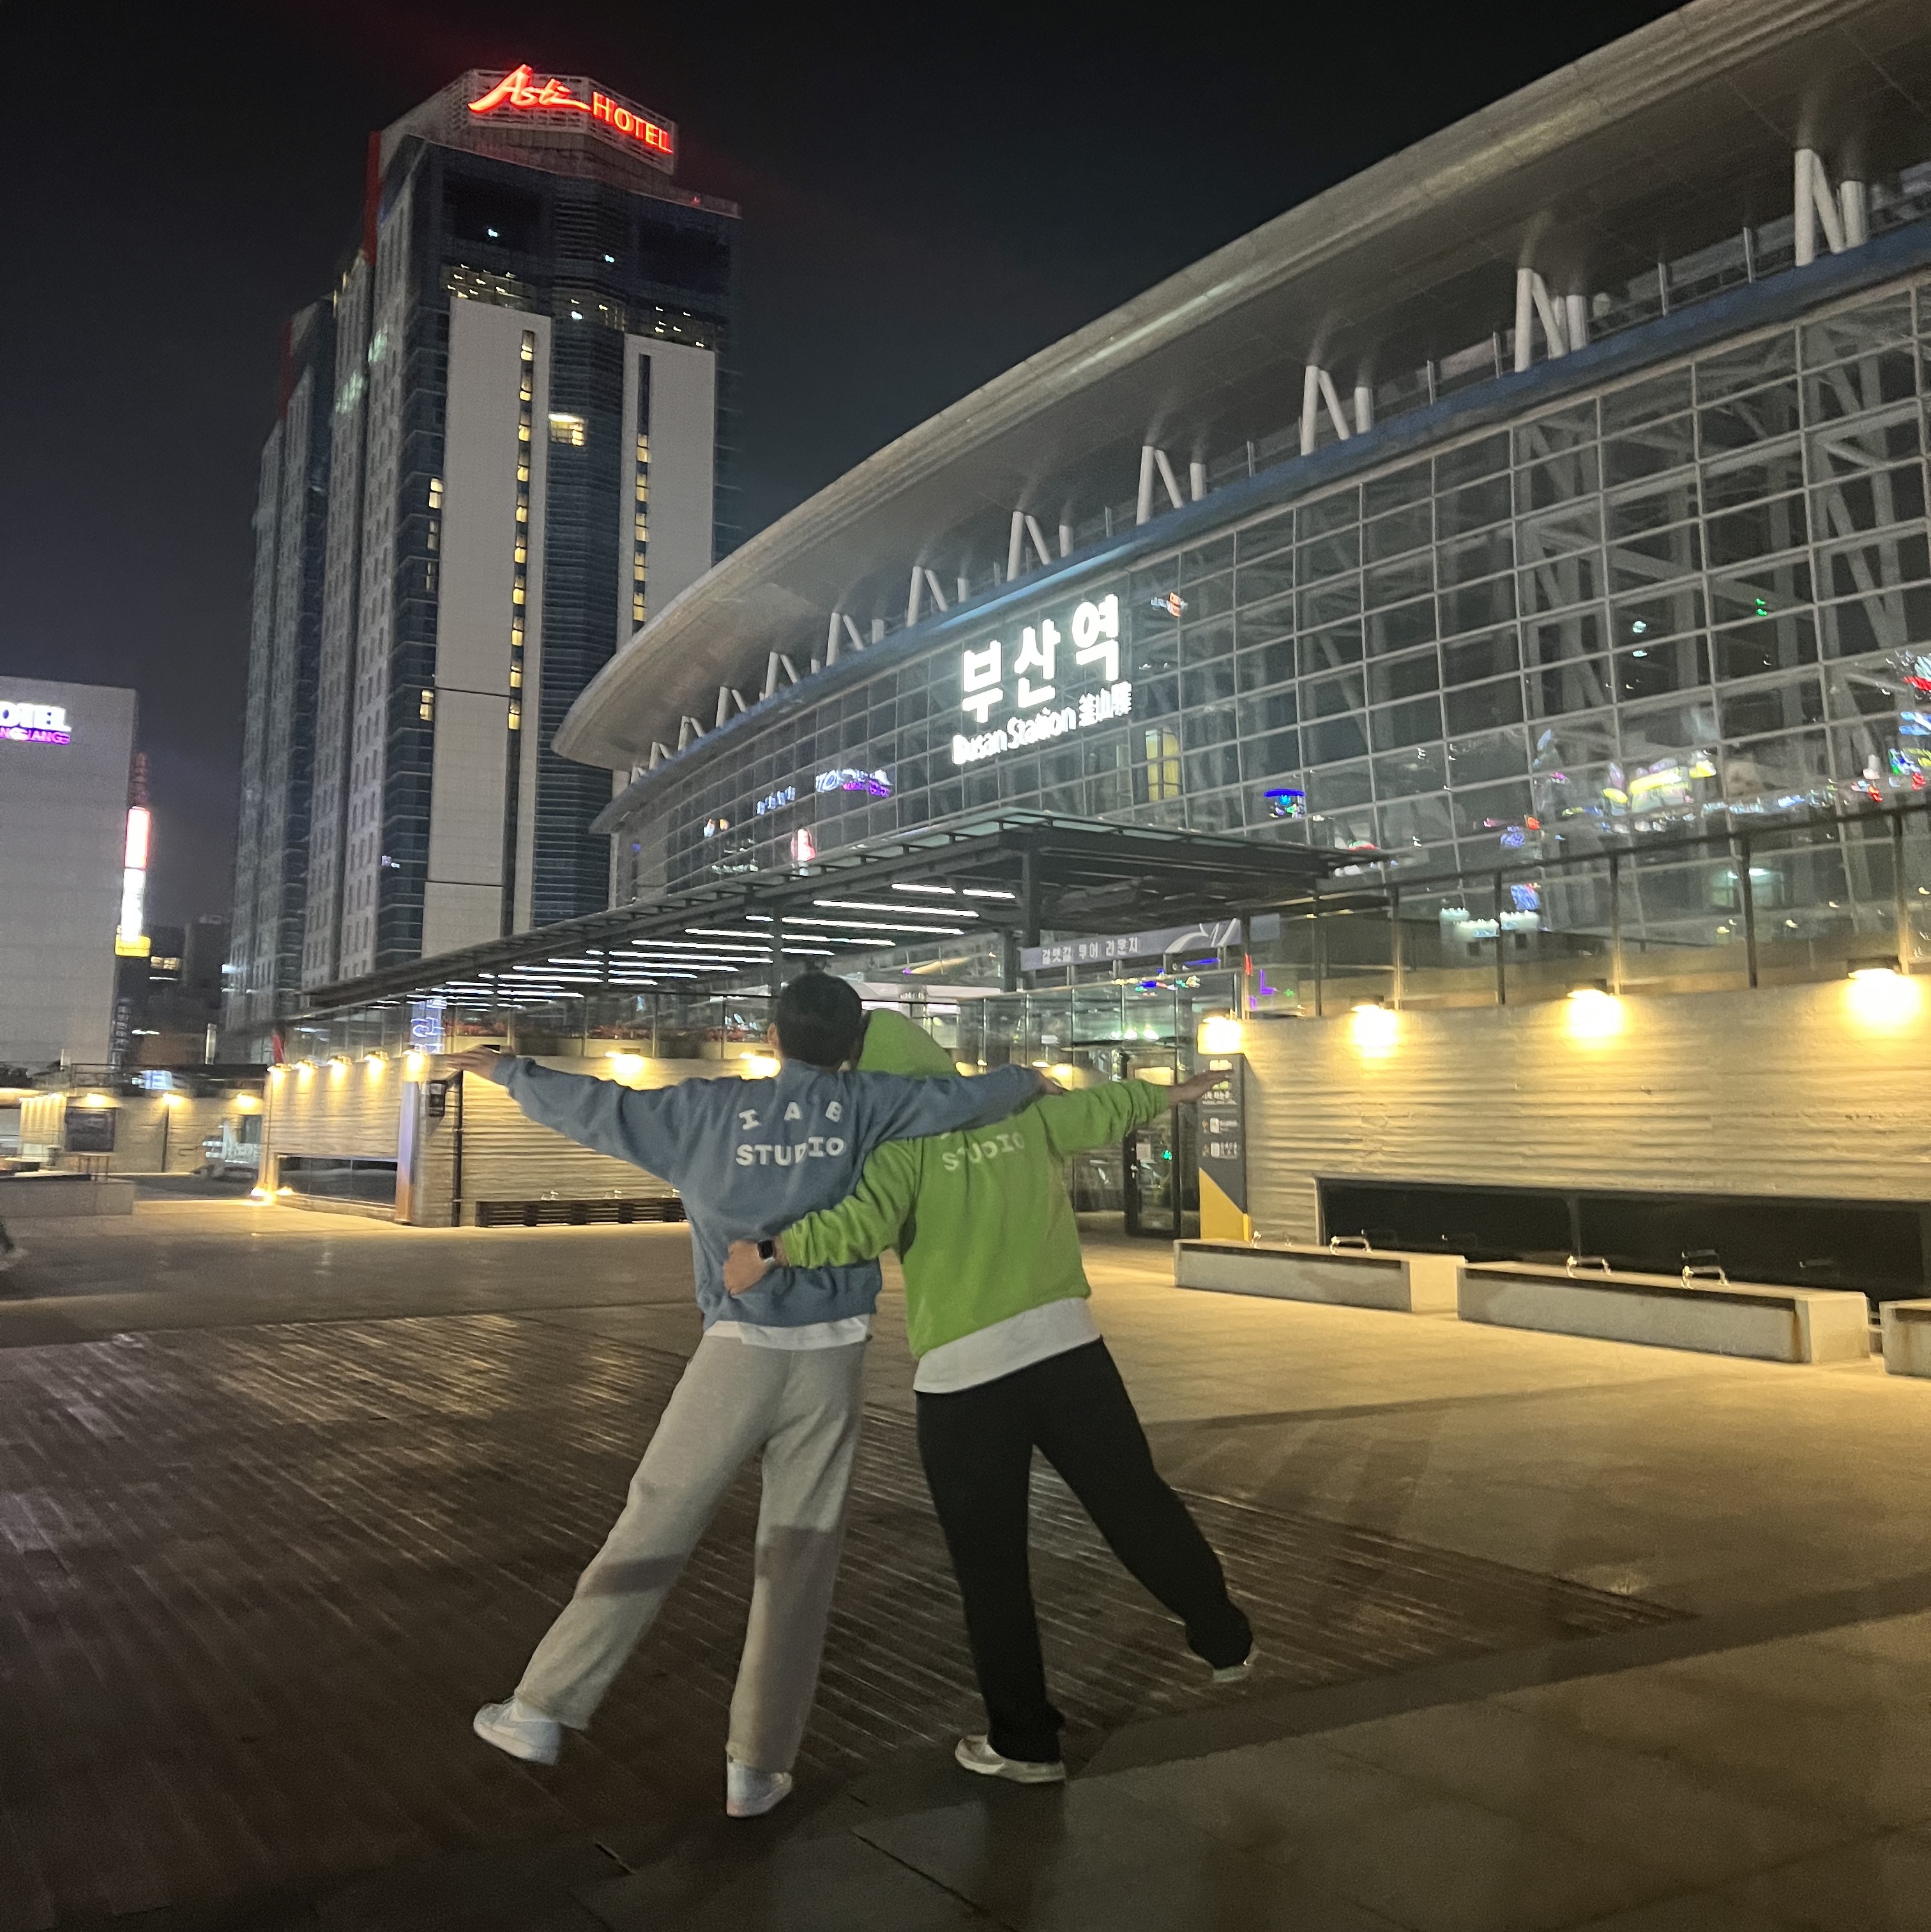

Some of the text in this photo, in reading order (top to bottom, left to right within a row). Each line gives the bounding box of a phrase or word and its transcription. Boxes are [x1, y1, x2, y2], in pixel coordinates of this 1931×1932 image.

[592, 91, 674, 154] HOTEL
[961, 593, 1119, 723] 부산역
[1007, 706, 1077, 749] Station
[736, 1136, 845, 1166] STUDIO
